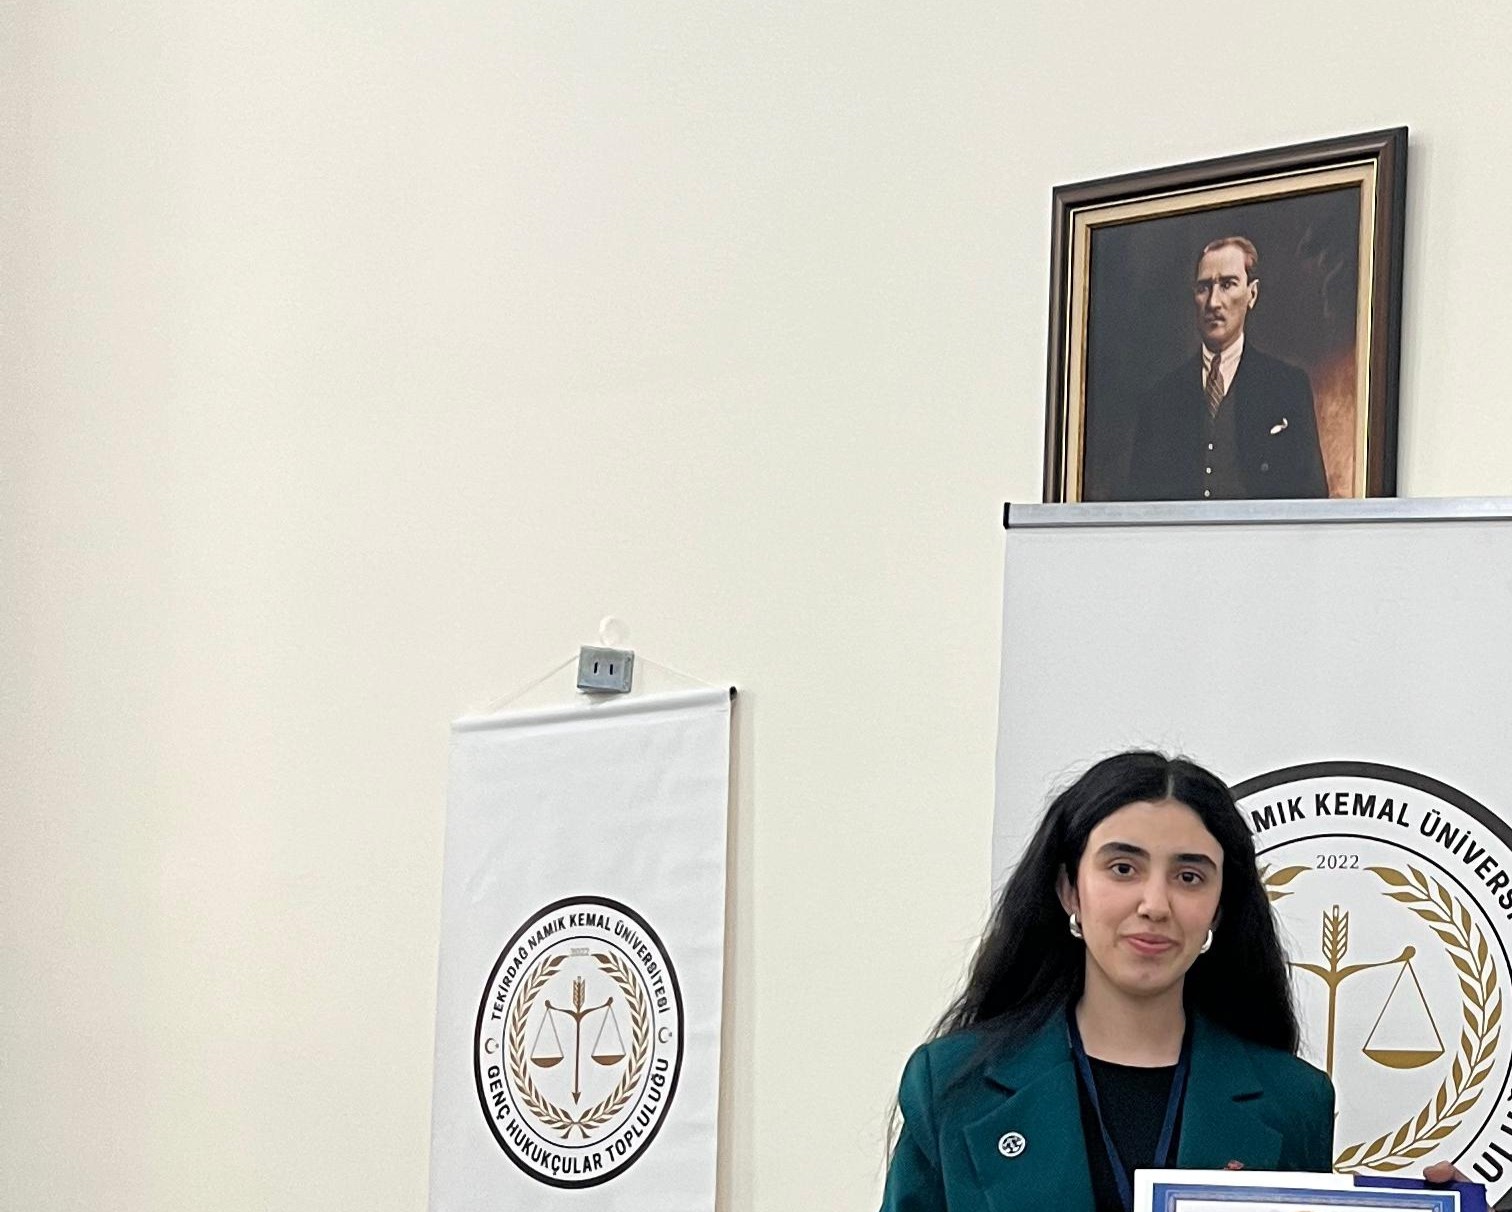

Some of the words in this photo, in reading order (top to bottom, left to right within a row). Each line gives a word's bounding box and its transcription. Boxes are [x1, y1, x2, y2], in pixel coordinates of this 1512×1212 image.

[1250, 796, 1306, 833] MIK
[1315, 792, 1411, 828] KEMAL
[1316, 854, 1360, 870] 2022
[527, 916, 567, 950] NAMIK
[569, 912, 611, 931] KEMAL
[487, 1065, 511, 1121] GENÇ
[505, 1118, 604, 1176] HUKUKÇULAR
[605, 1058, 670, 1163] TOPLULUĞU
